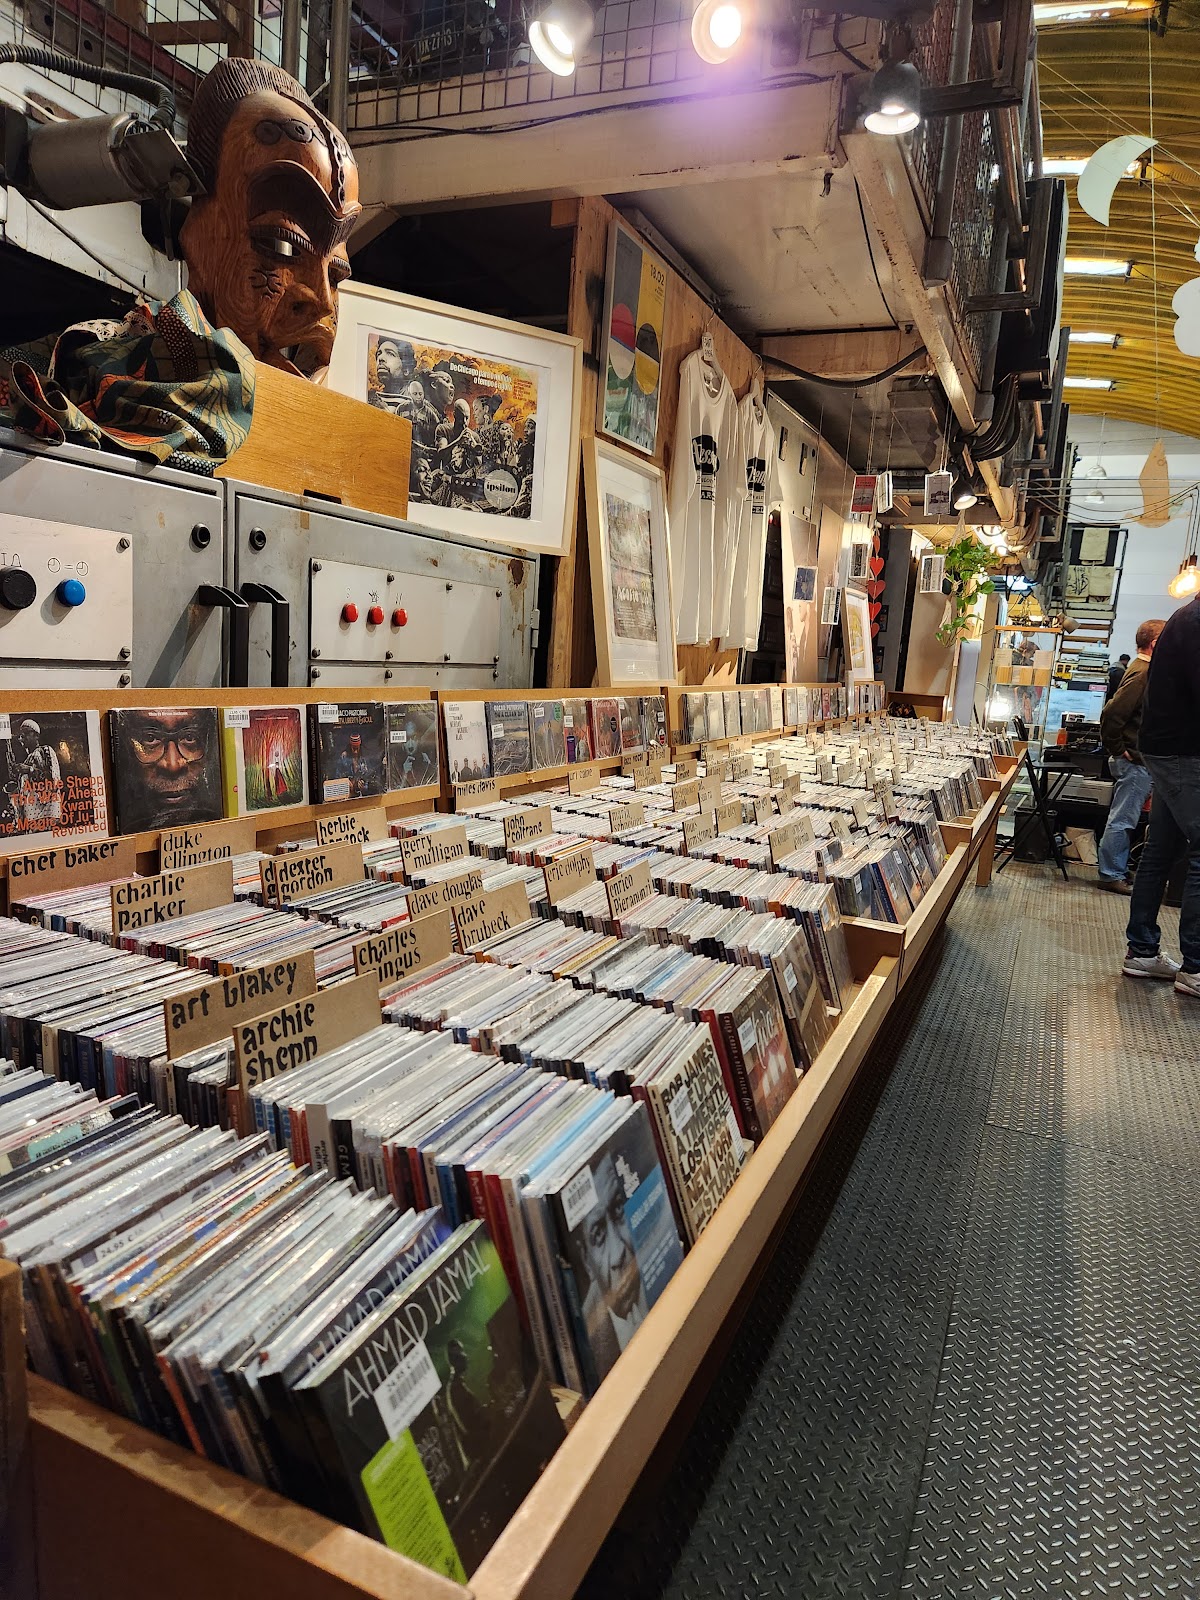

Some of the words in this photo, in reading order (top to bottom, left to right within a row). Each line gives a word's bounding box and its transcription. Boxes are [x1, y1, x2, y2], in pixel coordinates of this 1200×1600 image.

[10, 793, 35, 806] The
[38, 790, 66, 804] Way
[68, 785, 104, 800] Ahead
[23, 778, 64, 792] Archie
[66, 775, 104, 788] Shepp
[456, 784, 476, 796] miles
[477, 780, 496, 794] davis
[17, 816, 57, 832] Magic
[60, 812, 75, 826] Of
[76, 808, 106, 823] Ju-Ju
[60, 799, 106, 813] Kwanza
[52, 820, 107, 838] Revisited
[320, 815, 356, 838] herbie
[506, 814, 524, 833] john
[512, 822, 542, 842] coltrane
[163, 830, 203, 852] duke
[402, 834, 433, 859] gerry
[11, 853, 56, 878] chet
[64, 842, 119, 868] baker
[163, 844, 232, 869] ellington
[279, 855, 326, 883] dexter
[414, 842, 464, 869] mulligan
[548, 864, 564, 882] eric
[565, 856, 591, 877] dolphy
[116, 874, 184, 904] charlie
[280, 867, 333, 902] gordon
[411, 890, 439, 915] dave
[442, 874, 483, 904] douglas
[610, 874, 634, 898] enrico
[458, 899, 486, 928] dave
[462, 911, 511, 949] brubeck
[359, 928, 416, 966] charles
[362, 946, 421, 982] ingus
[172, 988, 210, 1029] art
[223, 961, 298, 1008] blakey
[242, 1002, 315, 1054] archie
[684, 1037, 714, 1090] JAMES
[693, 1057, 721, 1103] UPON
[678, 1131, 709, 1186] LOST
[685, 1154, 714, 1210] NEW
[700, 1149, 738, 1217] STUDIO
[342, 1302, 430, 1416] AHMAD
[426, 1239, 491, 1326] JAMAL
